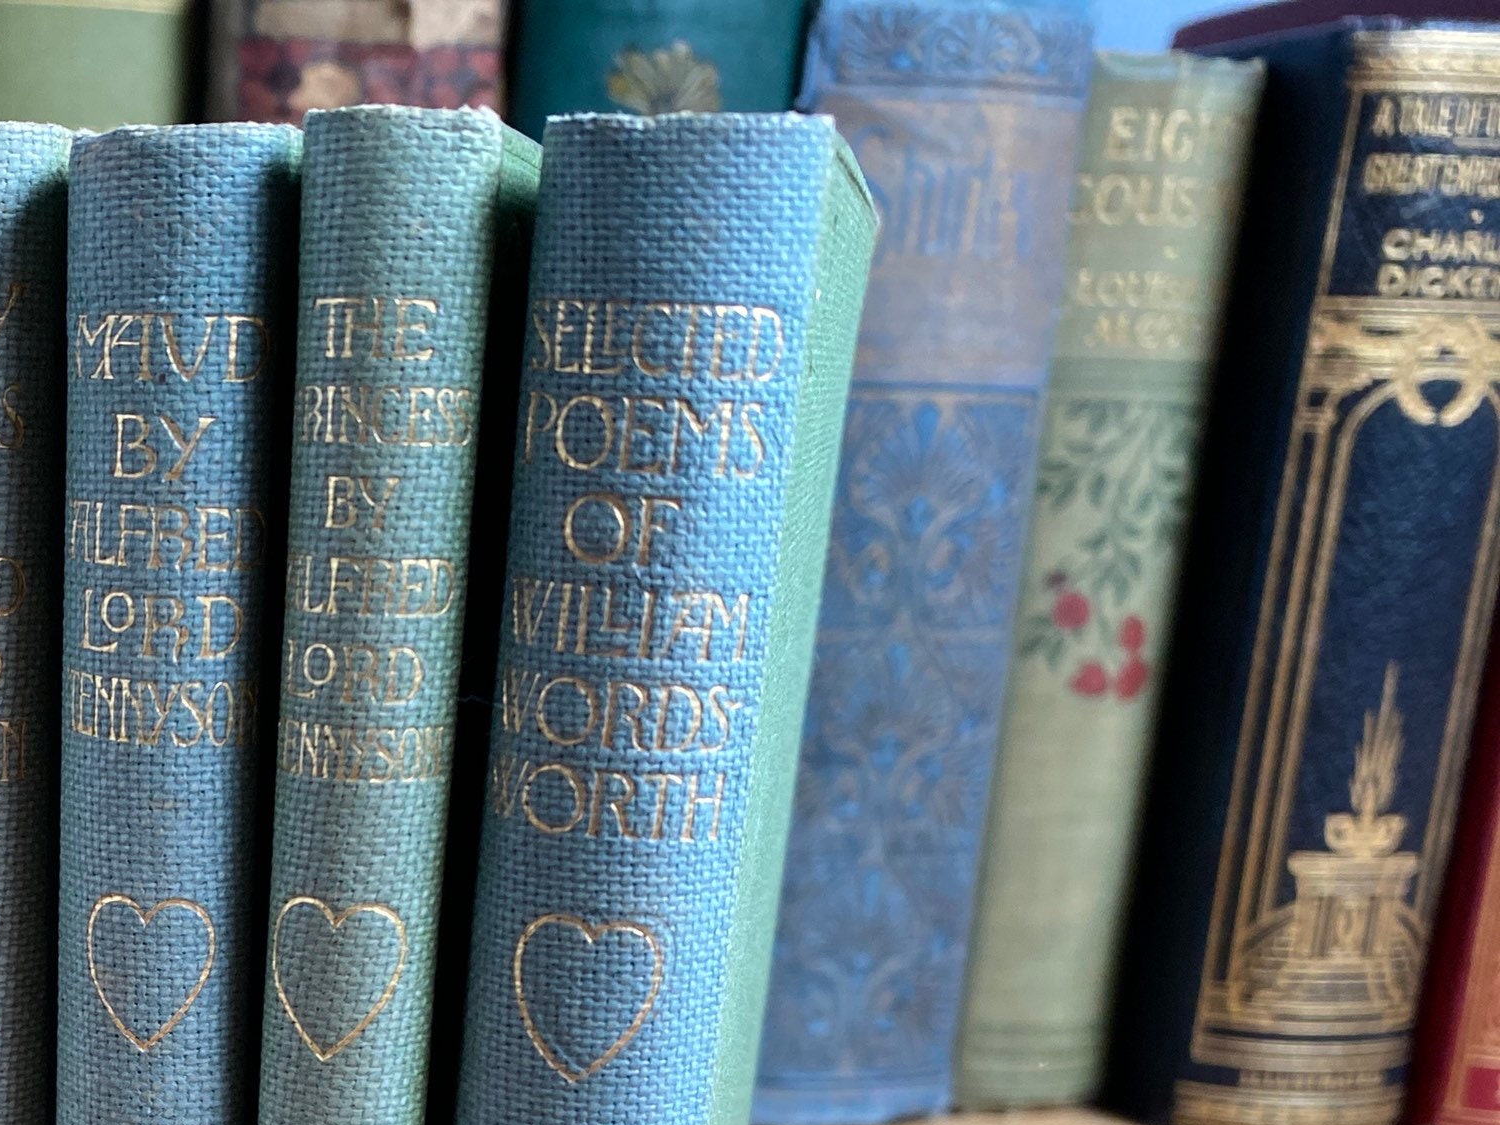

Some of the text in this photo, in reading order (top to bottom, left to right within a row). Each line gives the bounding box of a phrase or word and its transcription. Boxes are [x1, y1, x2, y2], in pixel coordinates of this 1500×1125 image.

[314, 297, 438, 361] THE
[532, 299, 783, 382] SELECTED
[111, 412, 216, 482] BY
[299, 384, 476, 447] RINCESS
[524, 391, 764, 480] POEMS
[69, 500, 267, 575] ALFRED
[324, 474, 400, 532] BY
[563, 491, 682, 566] OF
[80, 588, 244, 665] LORD
[512, 576, 750, 663] WILLIAM
[287, 638, 426, 706] LORD
[502, 668, 743, 752] WORDS
[279, 718, 446, 785] ENNYSON
[493, 756, 726, 843] WORTH
